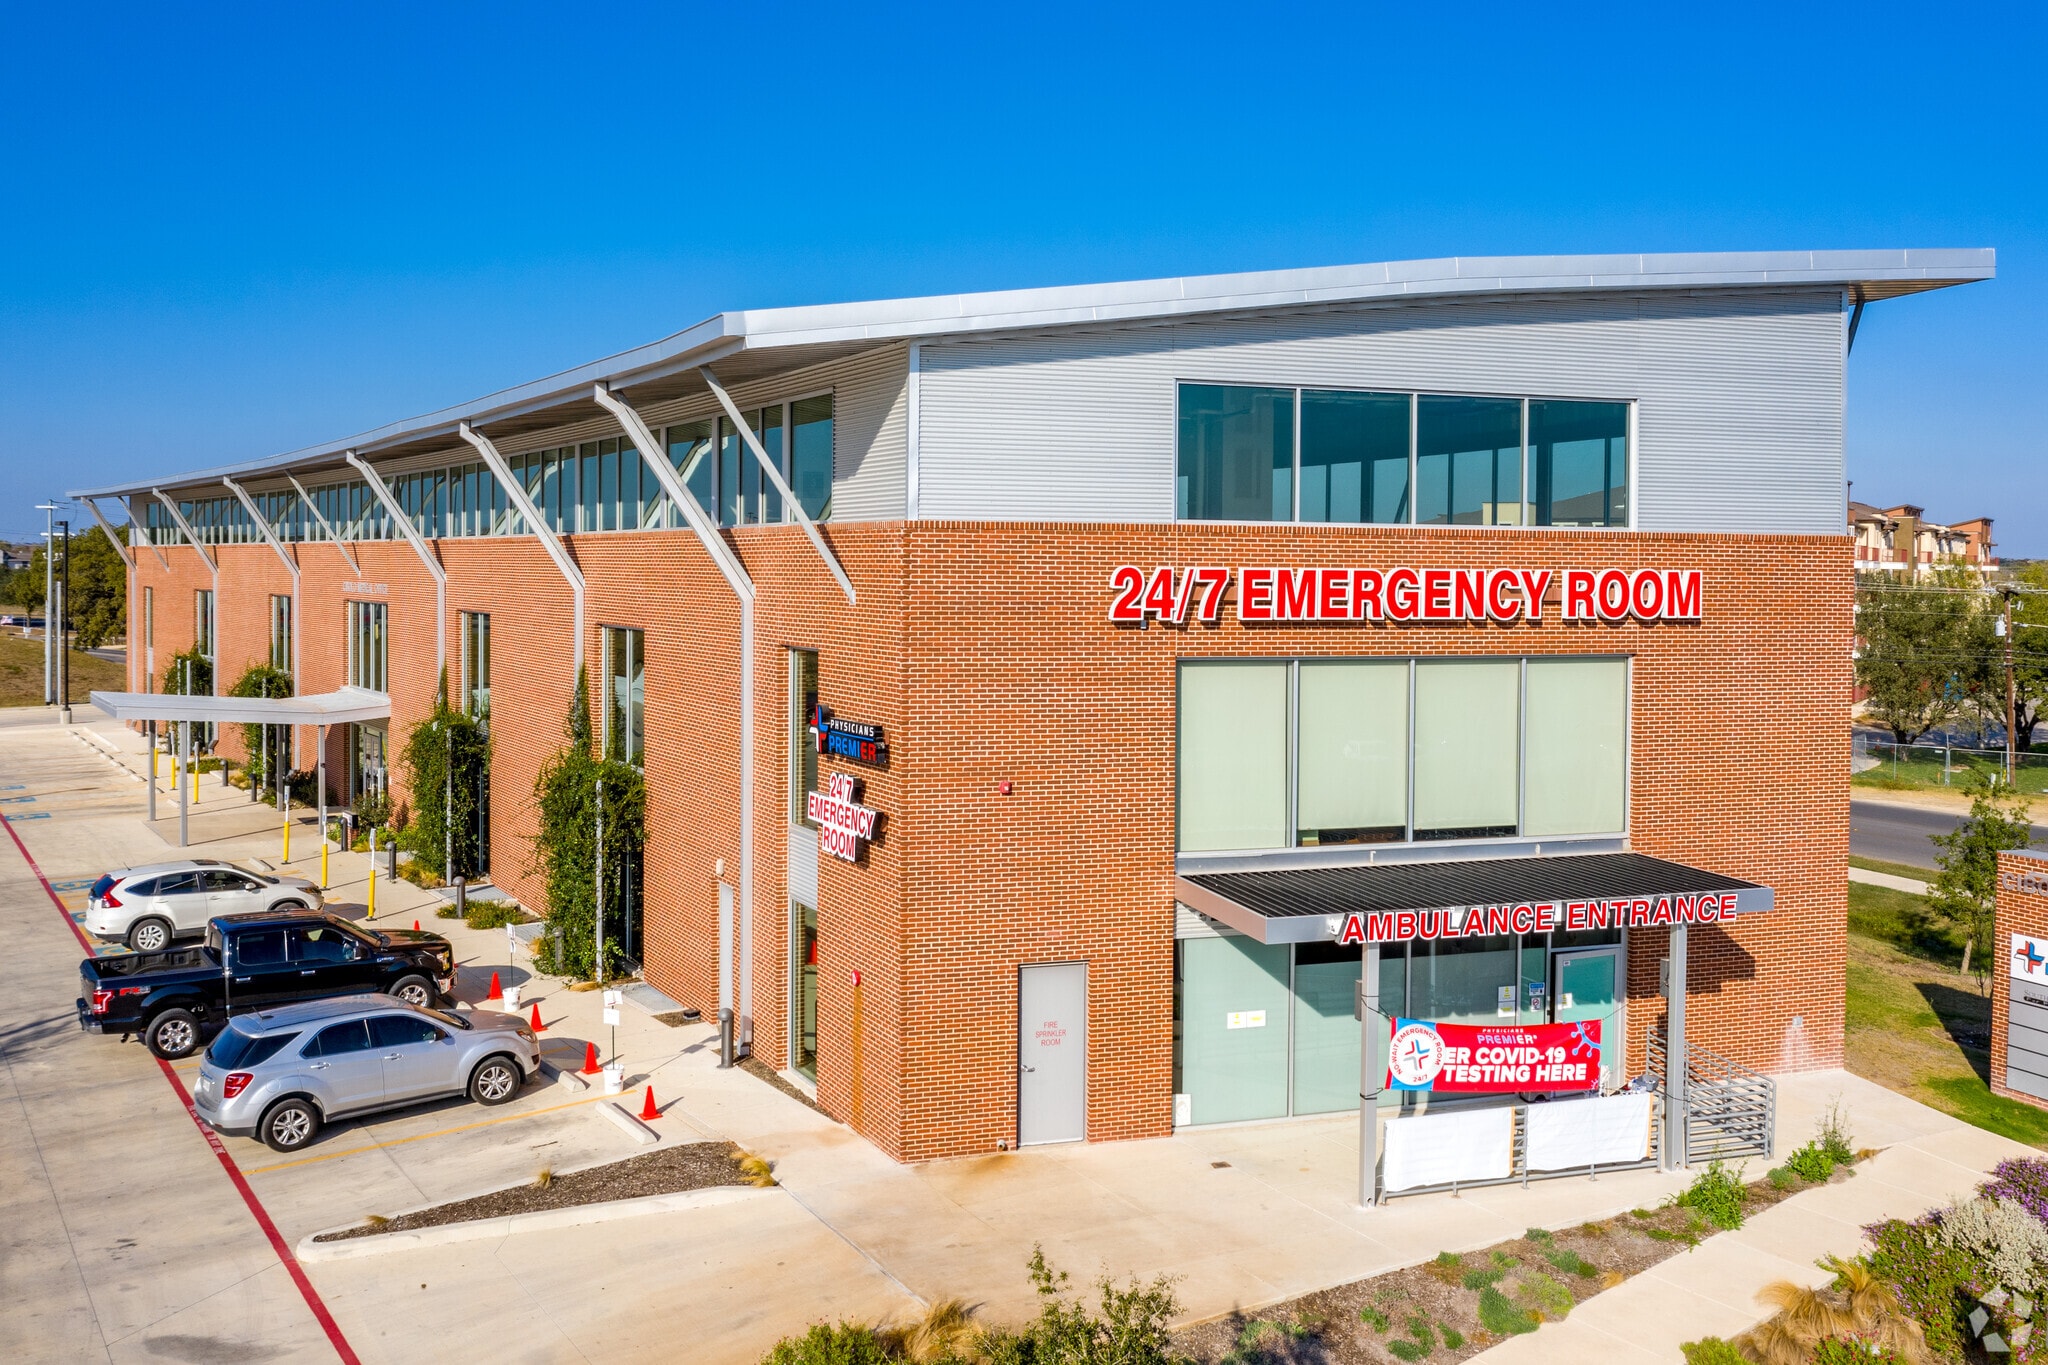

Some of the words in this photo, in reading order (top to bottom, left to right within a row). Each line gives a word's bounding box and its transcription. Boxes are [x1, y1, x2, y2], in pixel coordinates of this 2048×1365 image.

[1108, 565, 1229, 623] 24/7
[1237, 567, 1553, 621] EMERGENCY
[1561, 568, 1702, 620] ROOM
[830, 719, 875, 737] PHYSICIANS
[829, 736, 876, 761] PREMIER
[808, 792, 875, 839] EMERGENCY
[823, 825, 855, 861] ROOM
[1341, 903, 1555, 945] AMBULANCE
[1566, 893, 1739, 932] ENTRANCE
[1035, 1030, 1066, 1039] SPRINKLER
[1044, 1021, 1058, 1029] FIRE
[1041, 1039, 1061, 1047] ROOM
[1396, 1027, 1438, 1043] EMERGENCY
[1434, 1041, 1443, 1066] ROOM
[1444, 1047, 1471, 1064] ER
[1475, 1046, 1567, 1065] COVID-19
[1413, 1074, 1428, 1083] 24/7
[1443, 1064, 1531, 1083] TESTING
[1535, 1063, 1588, 1082] HERE
